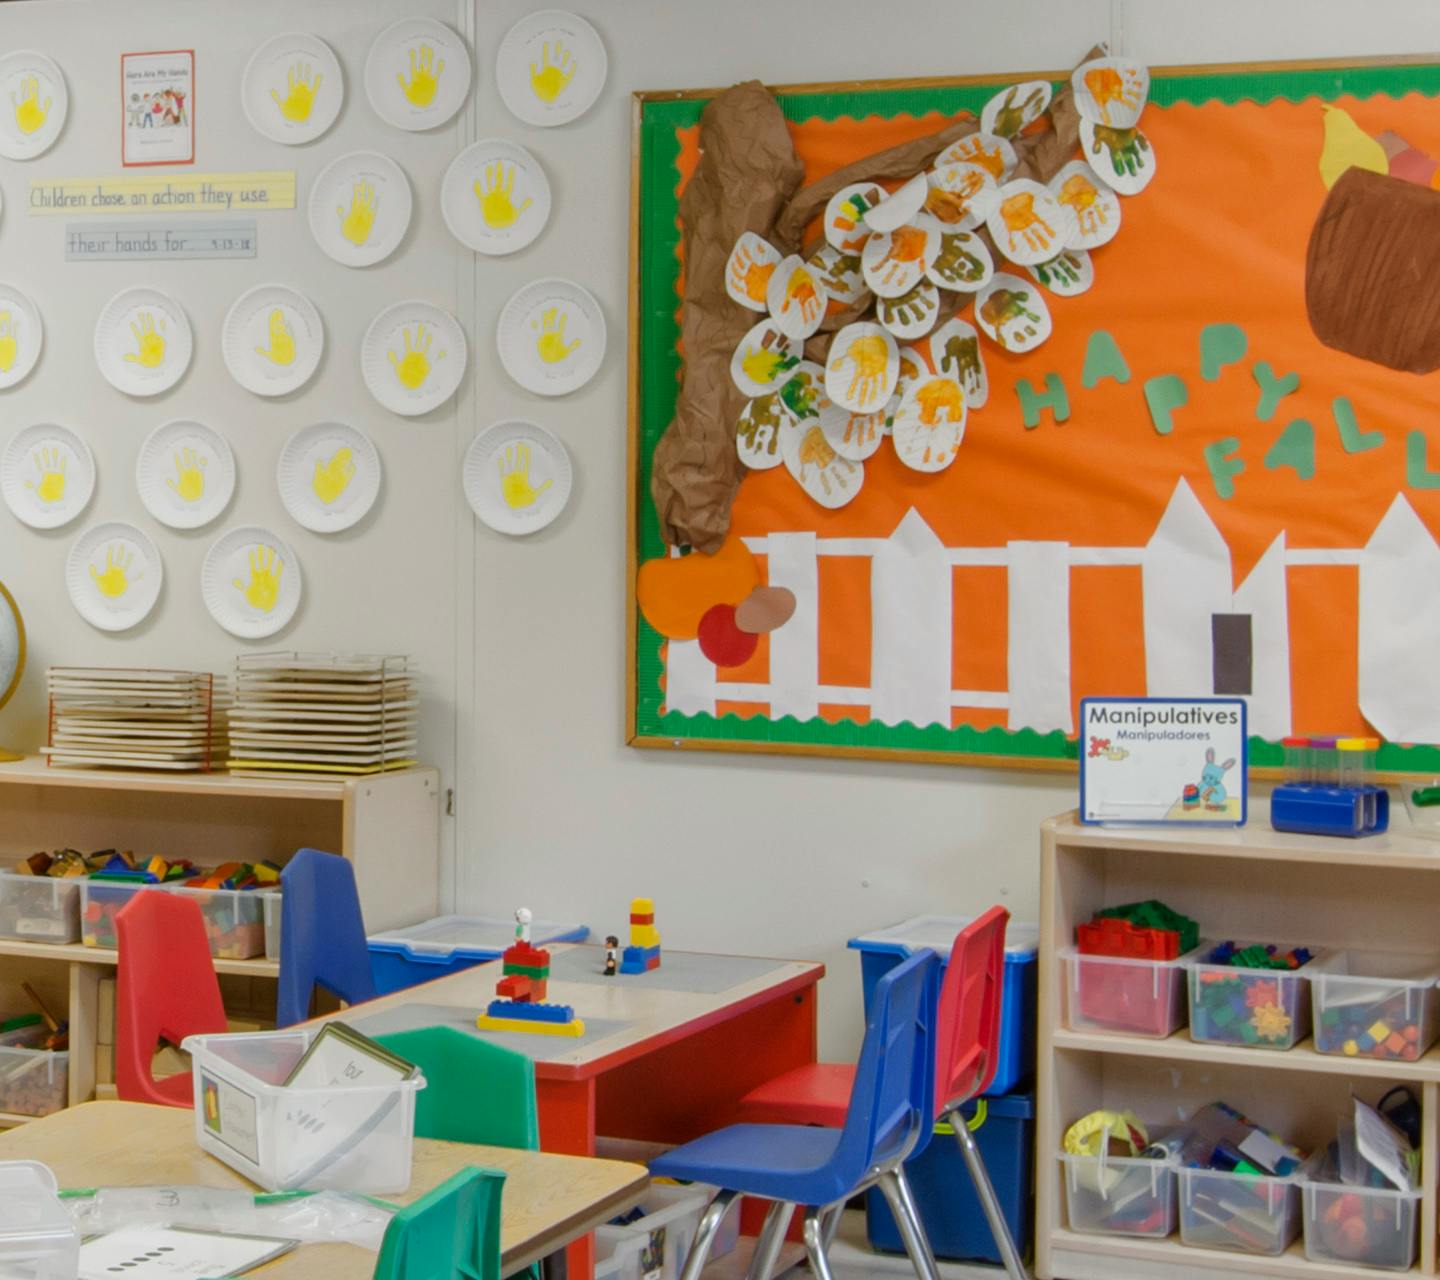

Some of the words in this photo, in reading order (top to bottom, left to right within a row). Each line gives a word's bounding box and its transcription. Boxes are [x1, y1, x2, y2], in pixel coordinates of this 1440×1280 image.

[30, 186, 87, 209] Children
[130, 191, 147, 206] an
[152, 183, 196, 206] action
[200, 183, 233, 209] they
[240, 189, 269, 204] use
[68, 232, 110, 254] their
[115, 231, 158, 253] hands
[1015, 323, 1301, 435] HAPPY
[1088, 706, 1238, 727] Manipulatives
[1116, 729, 1211, 742] Manipuladores
